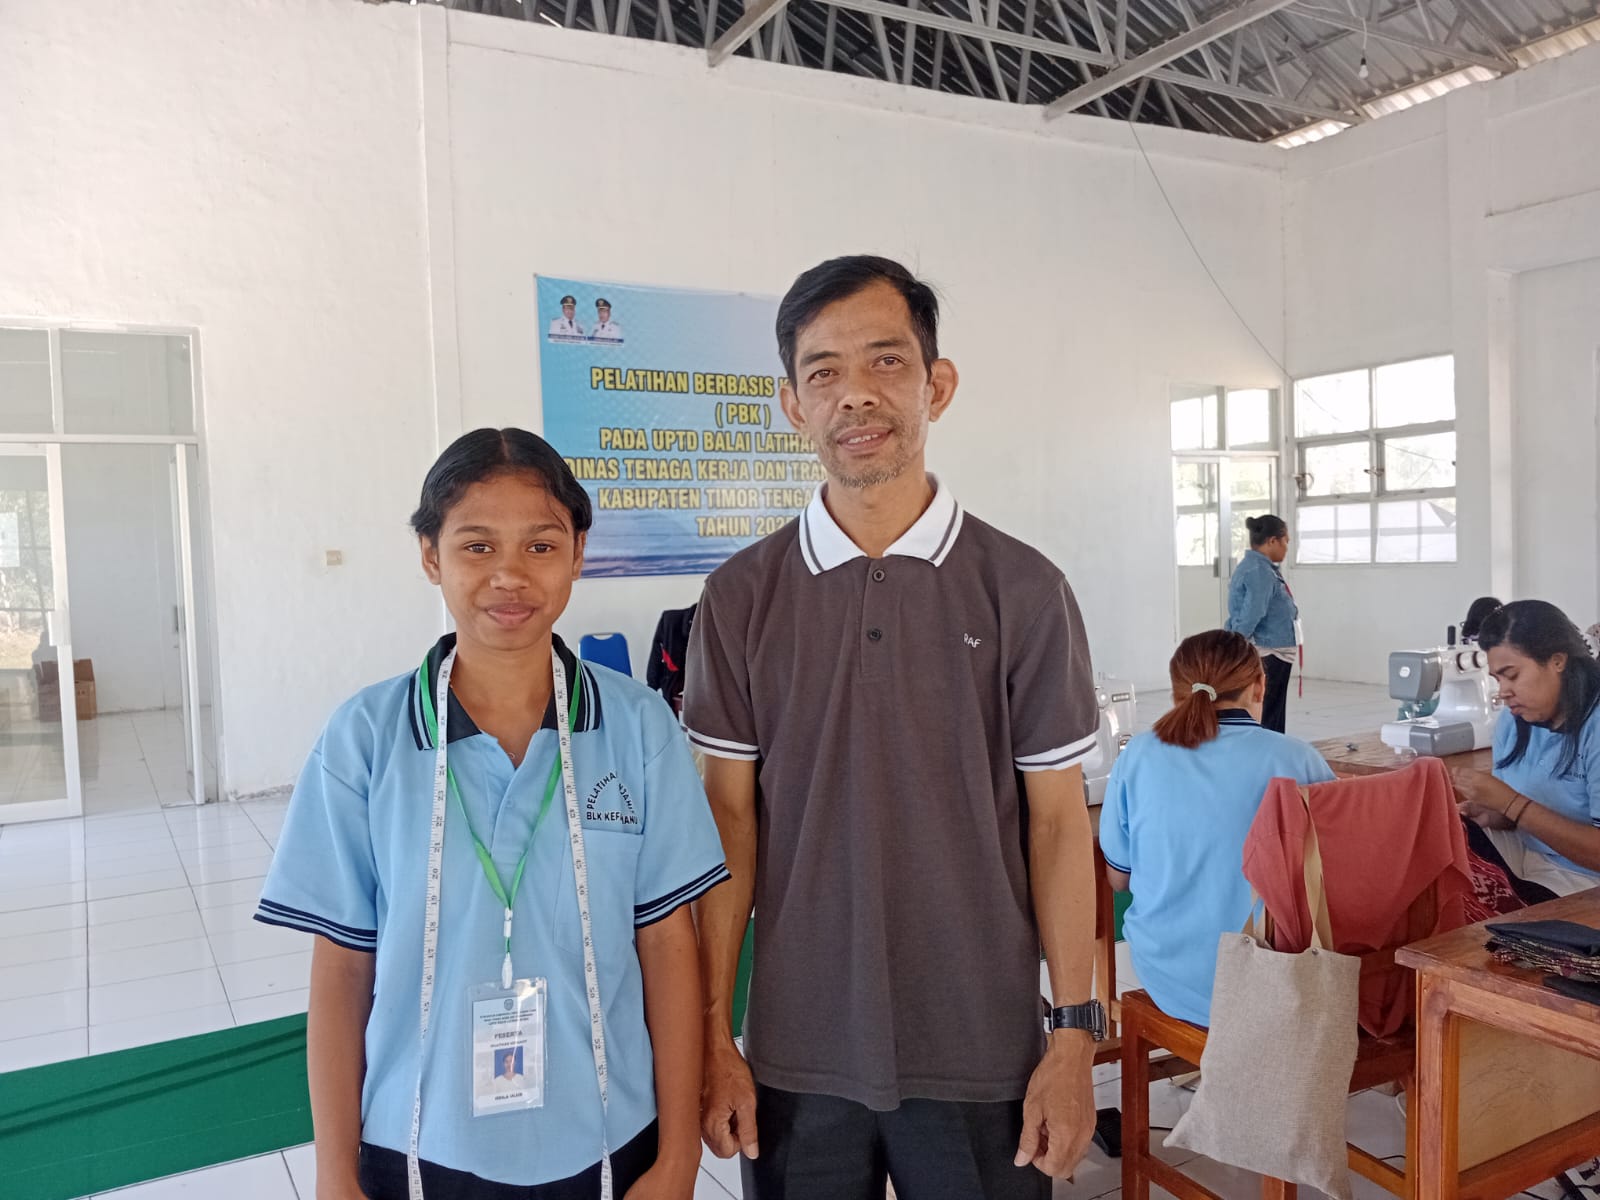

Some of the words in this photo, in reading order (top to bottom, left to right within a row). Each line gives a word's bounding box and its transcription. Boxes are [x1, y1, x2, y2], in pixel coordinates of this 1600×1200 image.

[590, 367, 689, 393] PELATIHAN
[693, 372, 775, 397] BERBASIS
[599, 427, 648, 450] PADA
[652, 429, 698, 452] UPTD
[703, 430, 752, 453] BALAI
[563, 456, 620, 480] DINAS
[623, 458, 693, 480] TENAGA
[697, 459, 750, 480] KERJA
[754, 459, 787, 481] DAN
[598, 487, 700, 509] KABUPATEN
[705, 487, 759, 509] TIMOR
[696, 515, 752, 537] TAHUN
[586, 811, 602, 821] BLK
